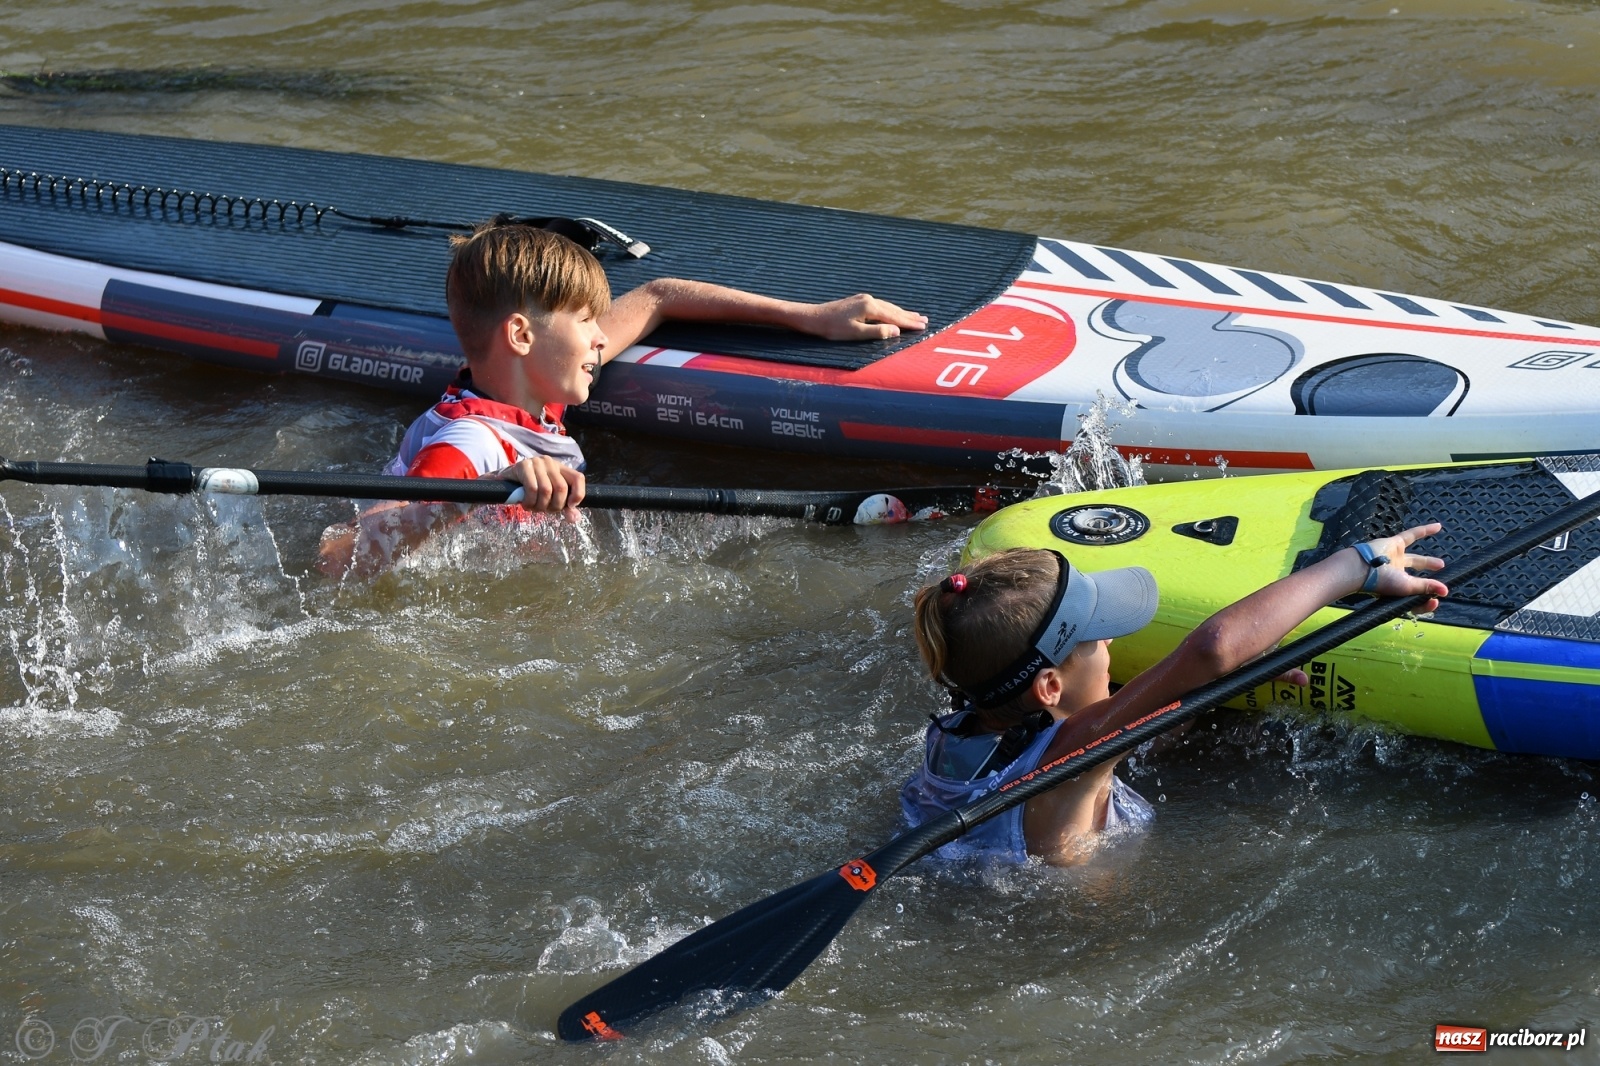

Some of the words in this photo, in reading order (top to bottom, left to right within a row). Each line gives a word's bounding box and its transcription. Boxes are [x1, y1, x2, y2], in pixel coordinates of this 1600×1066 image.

[656, 393, 693, 407] WIDTH
[770, 407, 820, 422] VOLUME
[997, 655, 1043, 695] HEADSW
[1309, 661, 1328, 709] BEAS
[1085, 729, 1124, 750] carbon
